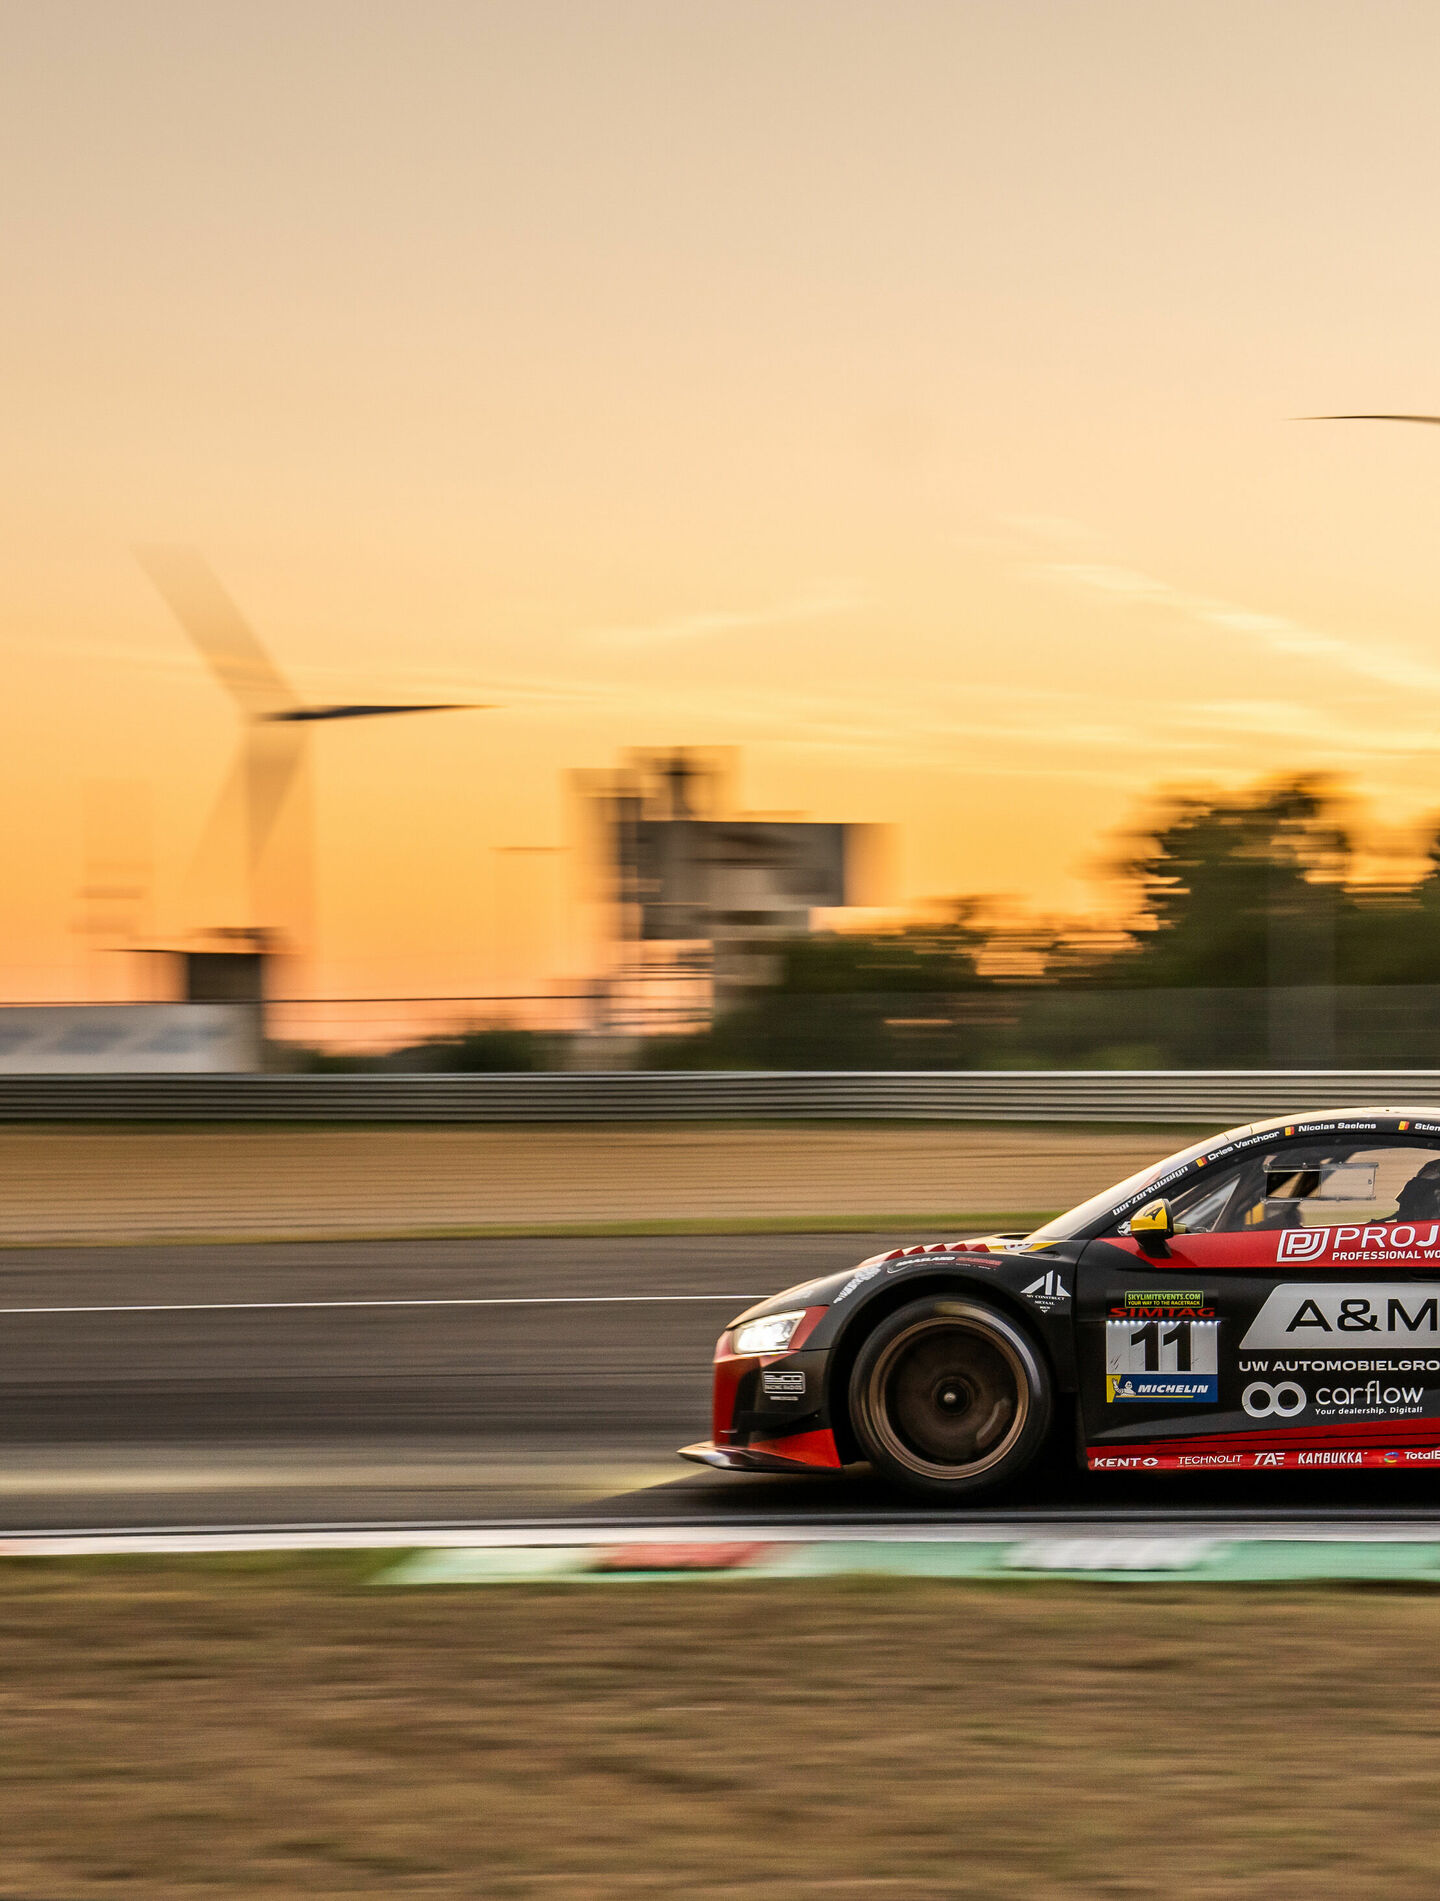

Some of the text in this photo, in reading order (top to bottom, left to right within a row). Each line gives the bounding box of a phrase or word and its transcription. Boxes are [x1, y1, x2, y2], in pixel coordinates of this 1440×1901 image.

[1298, 1122, 1377, 1133] Nicolas Saelens
[1207, 1130, 1280, 1161] Dries Vanthoor
[1332, 1251, 1421, 1262] PROFESSIONAL
[1127, 1293, 1201, 1301] SKYLIMITEVENTS.COM
[1108, 1307, 1216, 1318] SIMTAG
[1285, 1298, 1439, 1332] A&M
[1130, 1322, 1192, 1372] 11
[1238, 1360, 1270, 1372] UW
[1137, 1384, 1209, 1394] MICHELIN
[1315, 1381, 1424, 1405] carflow
[1338, 1407, 1388, 1416] dealership.
[1389, 1406, 1423, 1415] Digital!
[1094, 1457, 1142, 1467] KENT
[1178, 1454, 1243, 1465] TECHNOLIT
[1298, 1452, 1363, 1464] KAMBUKKA
